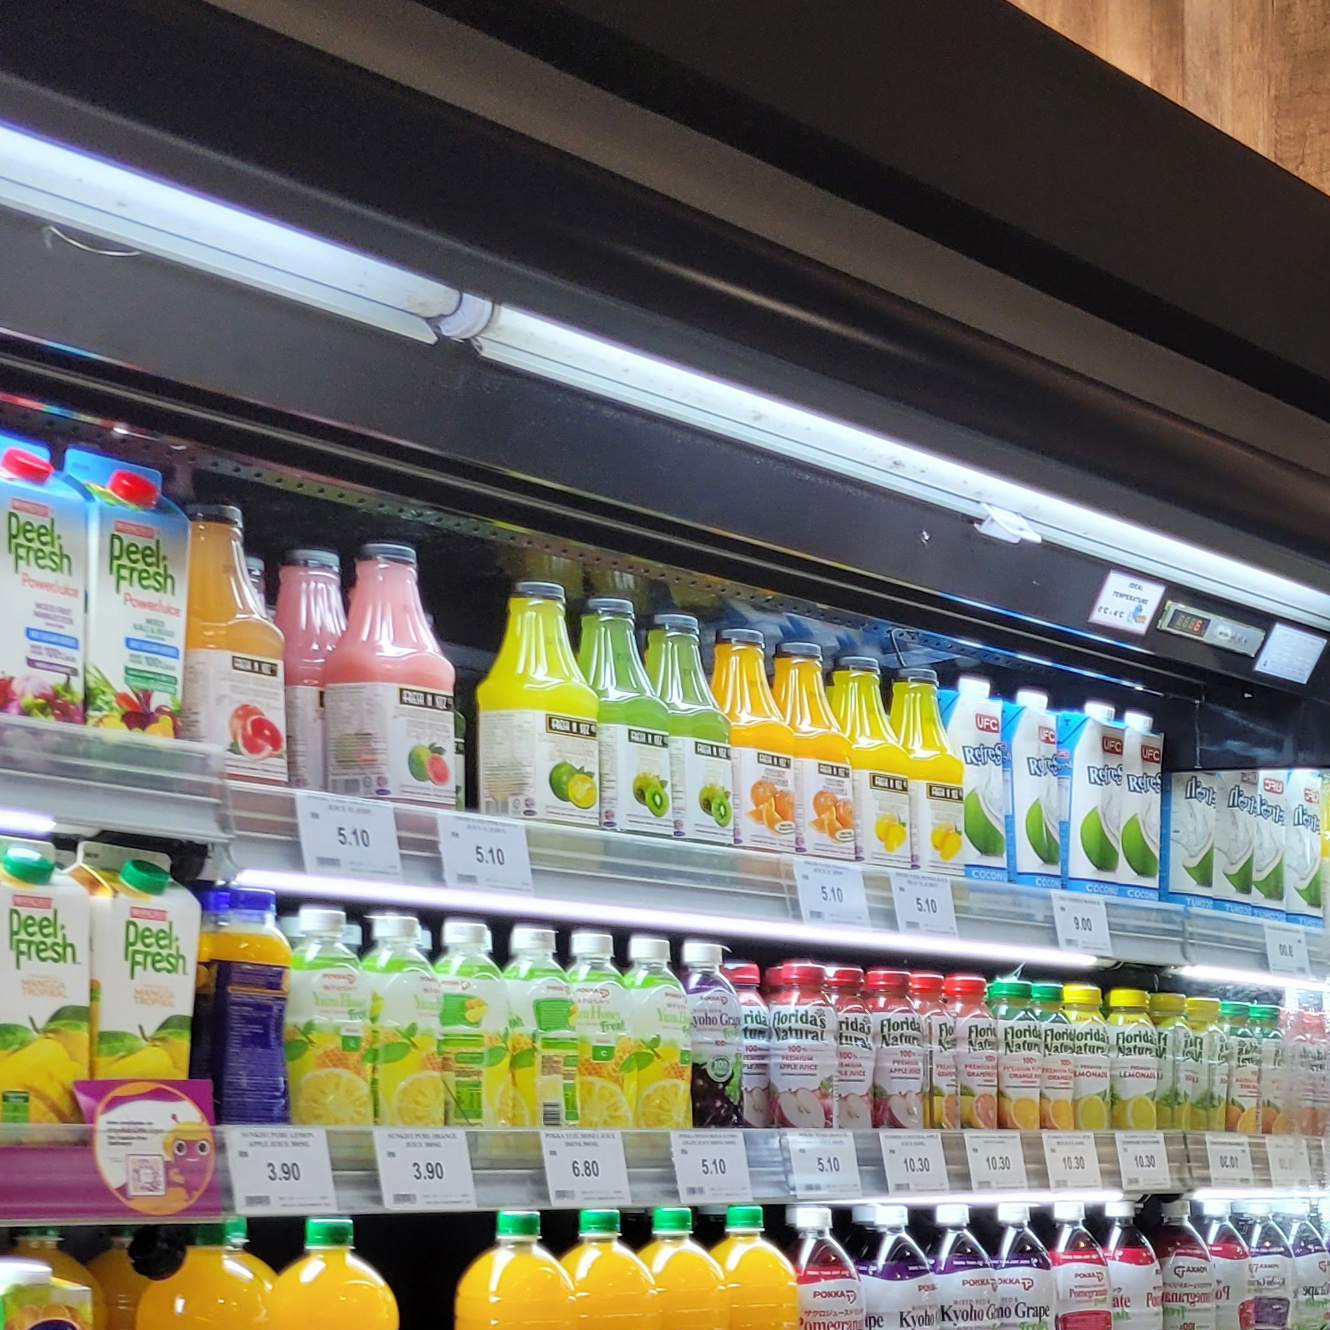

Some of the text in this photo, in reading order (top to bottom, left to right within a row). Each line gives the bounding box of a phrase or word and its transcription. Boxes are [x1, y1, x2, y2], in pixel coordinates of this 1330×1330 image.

[15, 535, 71, 576] Fresh
[116, 555, 175, 596] Fresh
[337, 827, 371, 848] 5.10
[475, 845, 505, 866] 5.10
[821, 886, 843, 903] 5.10
[916, 898, 937, 915] 5.10
[1073, 917, 1092, 932] 9.00
[15, 937, 77, 969] Fresh
[130, 946, 186, 979] Fresh
[571, 1159, 600, 1178] 6.80
[702, 1158, 726, 1175] 5.10
[818, 1158, 840, 1173] 5.10
[903, 1156, 930, 1173] 10.30
[986, 1156, 1011, 1171] 10.30
[1062, 1156, 1086, 1171] 10.30
[1134, 1154, 1156, 1169] 10.30
[268, 1162, 301, 1182] 3.90
[412, 1162, 444, 1181] 3.90
[813, 1290, 845, 1299] POKKA
[941, 1302, 984, 1322] Kyoho
[1015, 1303, 1049, 1318] Grape
